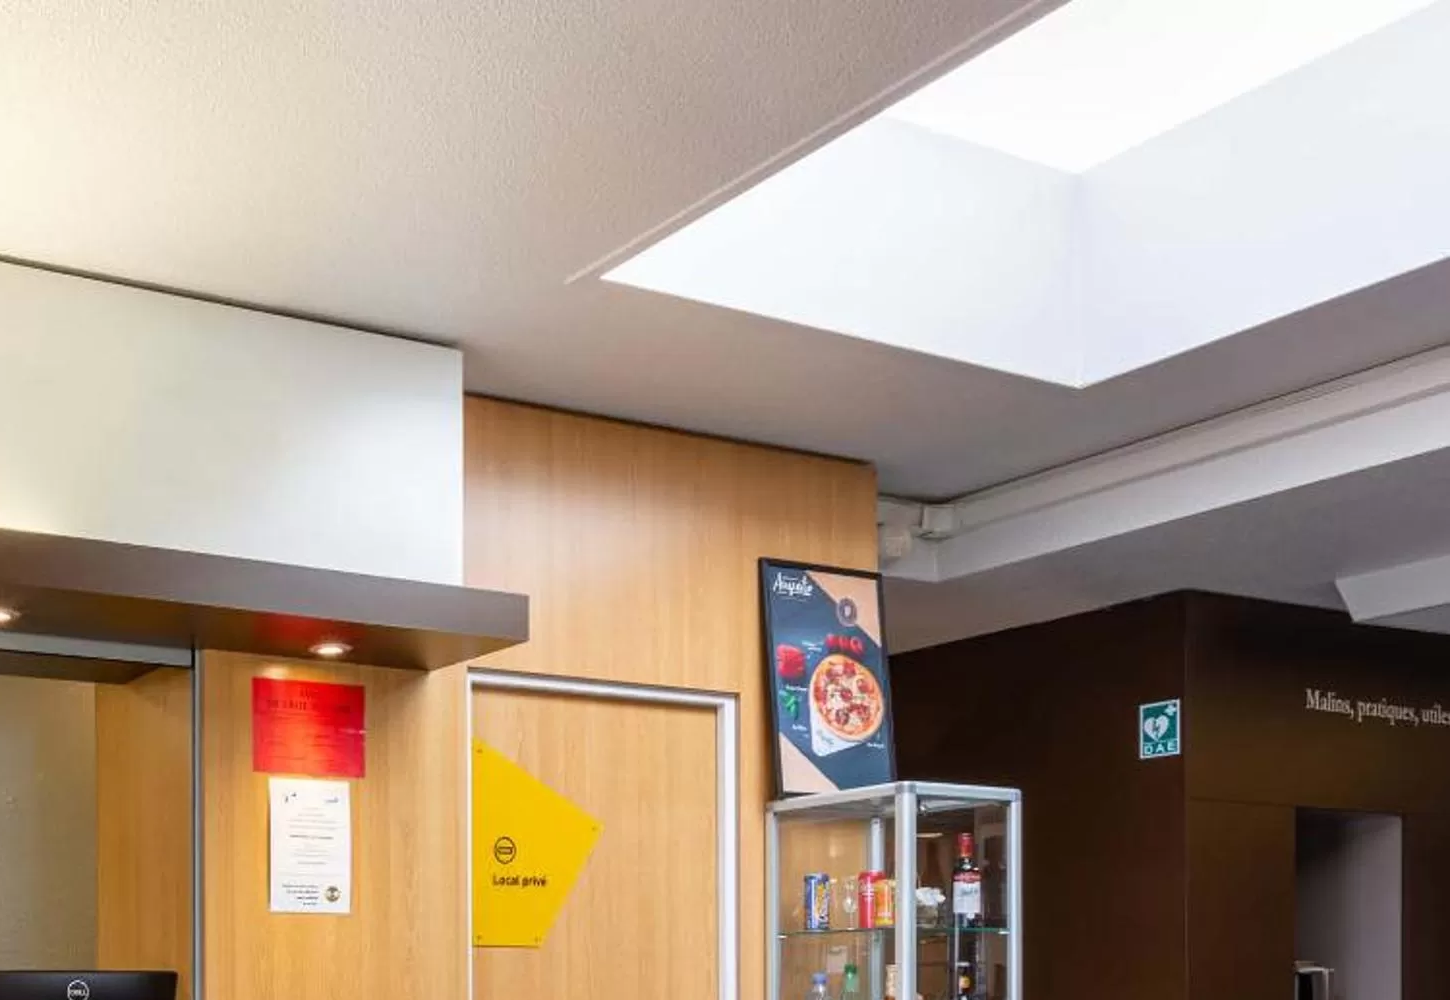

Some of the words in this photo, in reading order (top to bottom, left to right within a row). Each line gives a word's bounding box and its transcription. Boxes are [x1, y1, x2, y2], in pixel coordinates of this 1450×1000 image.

[1305, 687, 1355, 719] Malins,
[1357, 697, 1419, 726] pratiques,
[1144, 740, 1177, 755] DAE
[492, 874, 520, 886] Local
